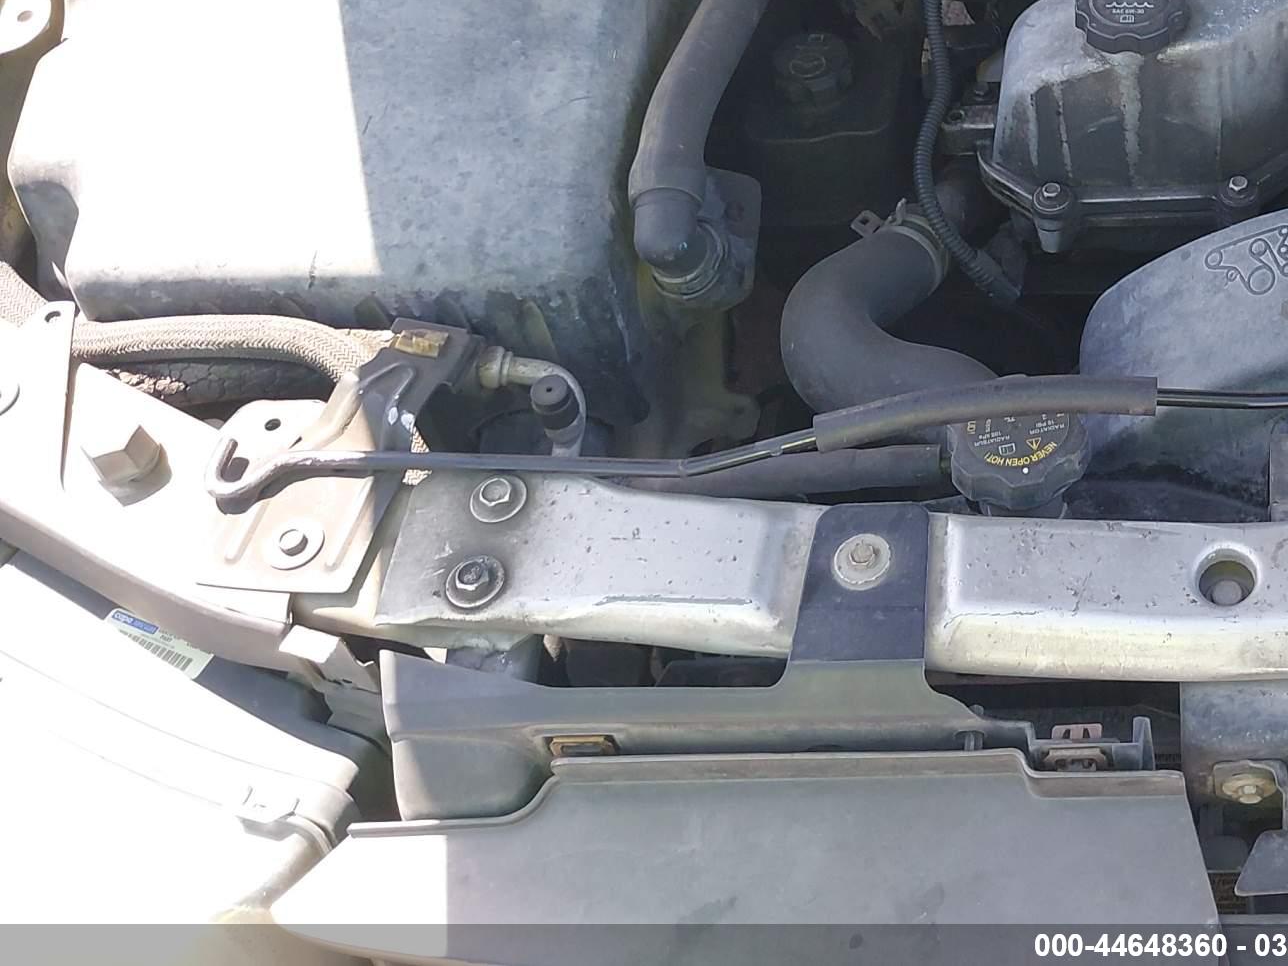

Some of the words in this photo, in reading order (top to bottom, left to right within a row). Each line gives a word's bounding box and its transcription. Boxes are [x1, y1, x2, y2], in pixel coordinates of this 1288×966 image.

[984, 451, 1003, 466] HOT!
[1032, 441, 1058, 462] NEVER
[1005, 456, 1031, 467] OPEN
